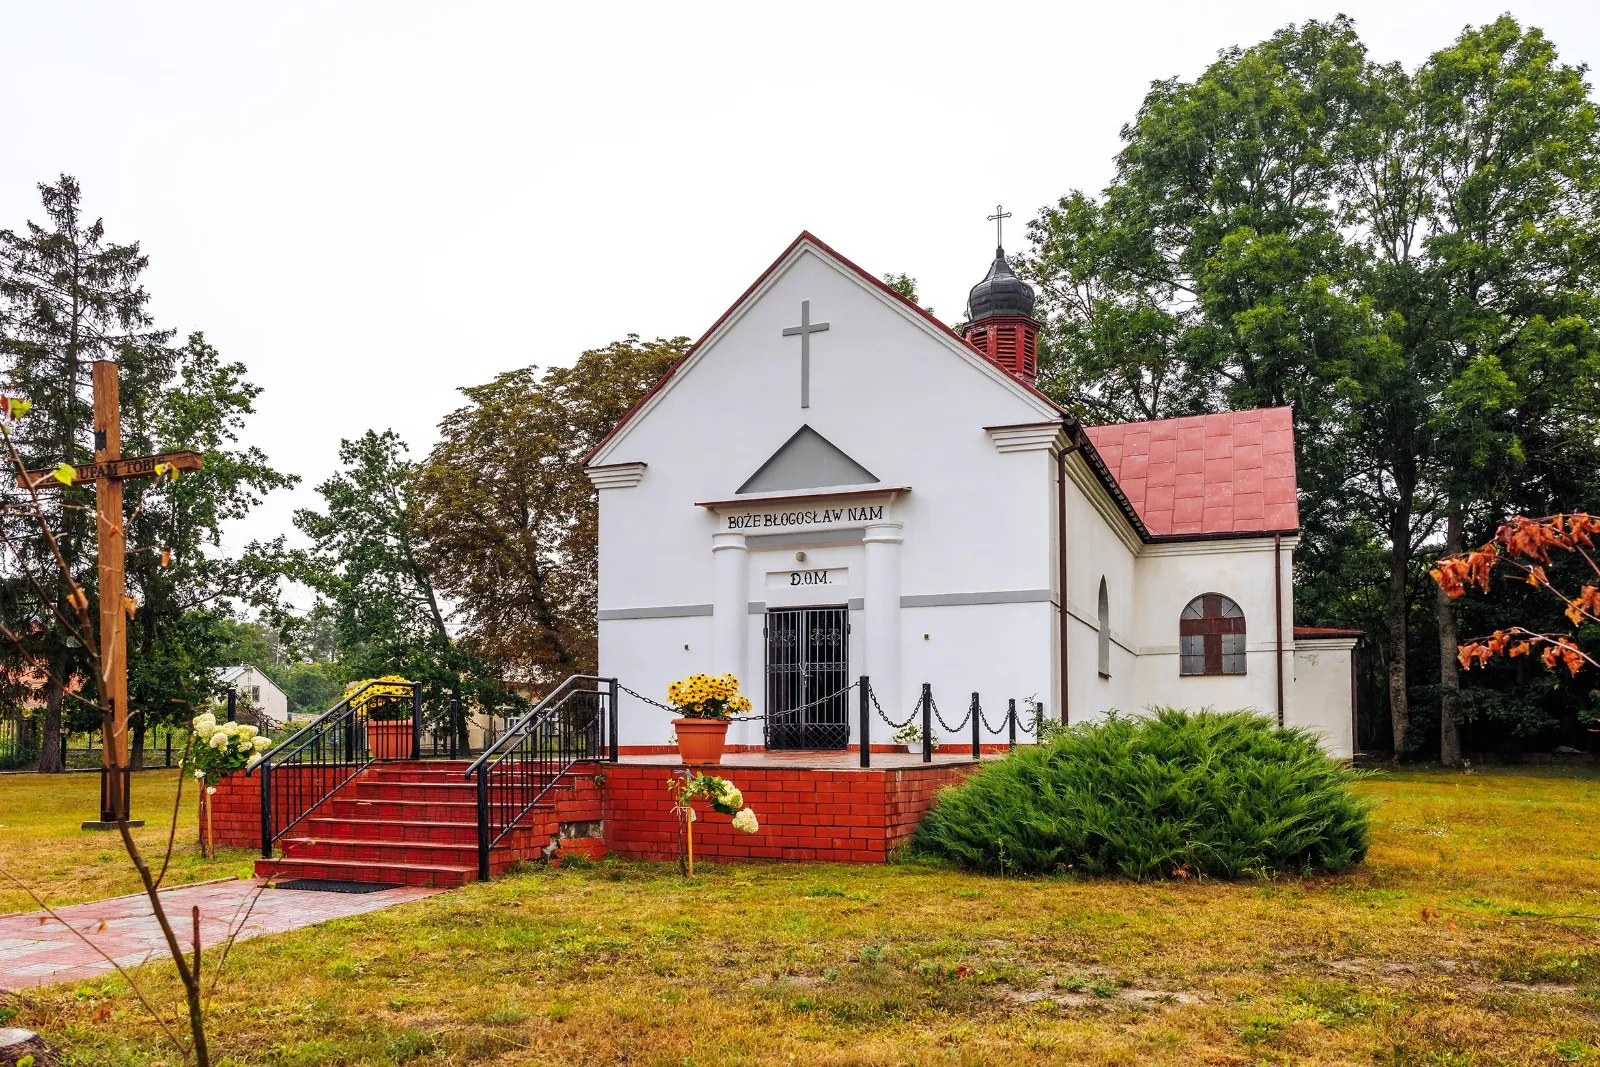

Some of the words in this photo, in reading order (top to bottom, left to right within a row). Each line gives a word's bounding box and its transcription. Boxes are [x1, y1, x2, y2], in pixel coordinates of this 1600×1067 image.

[80, 463, 119, 479] UFAM
[727, 512, 762, 529] BOŻE
[763, 508, 845, 527] BŁOGOSŁAW
[847, 505, 884, 522] NAM
